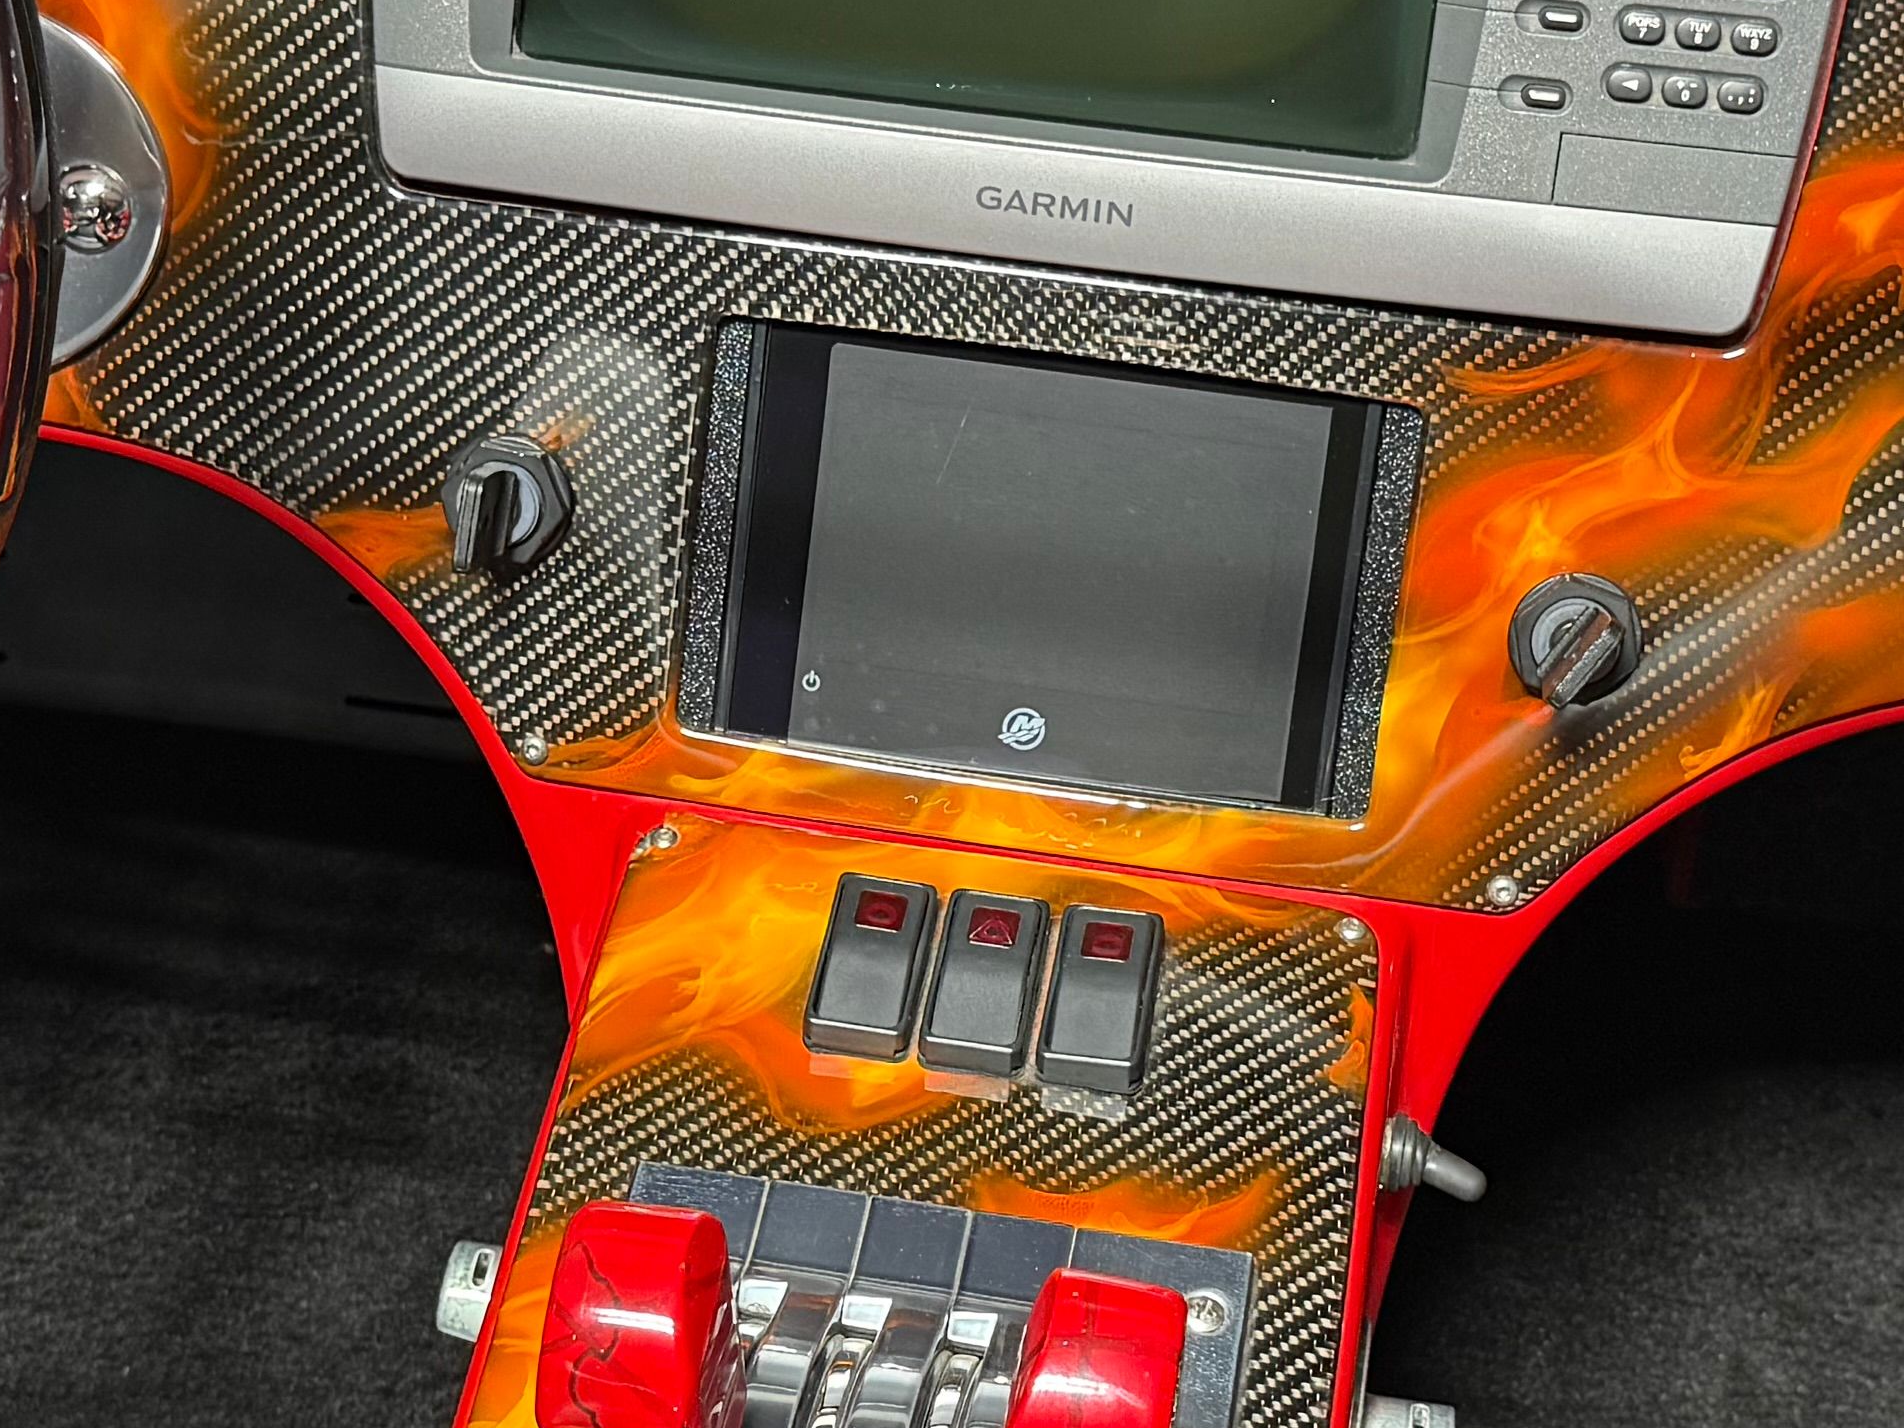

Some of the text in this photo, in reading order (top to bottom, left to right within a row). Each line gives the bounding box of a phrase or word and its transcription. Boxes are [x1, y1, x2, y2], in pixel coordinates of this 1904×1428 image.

[1689, 21, 1712, 33] TUV
[1639, 28, 1647, 39] 7
[975, 185, 1133, 227] GARMIN
